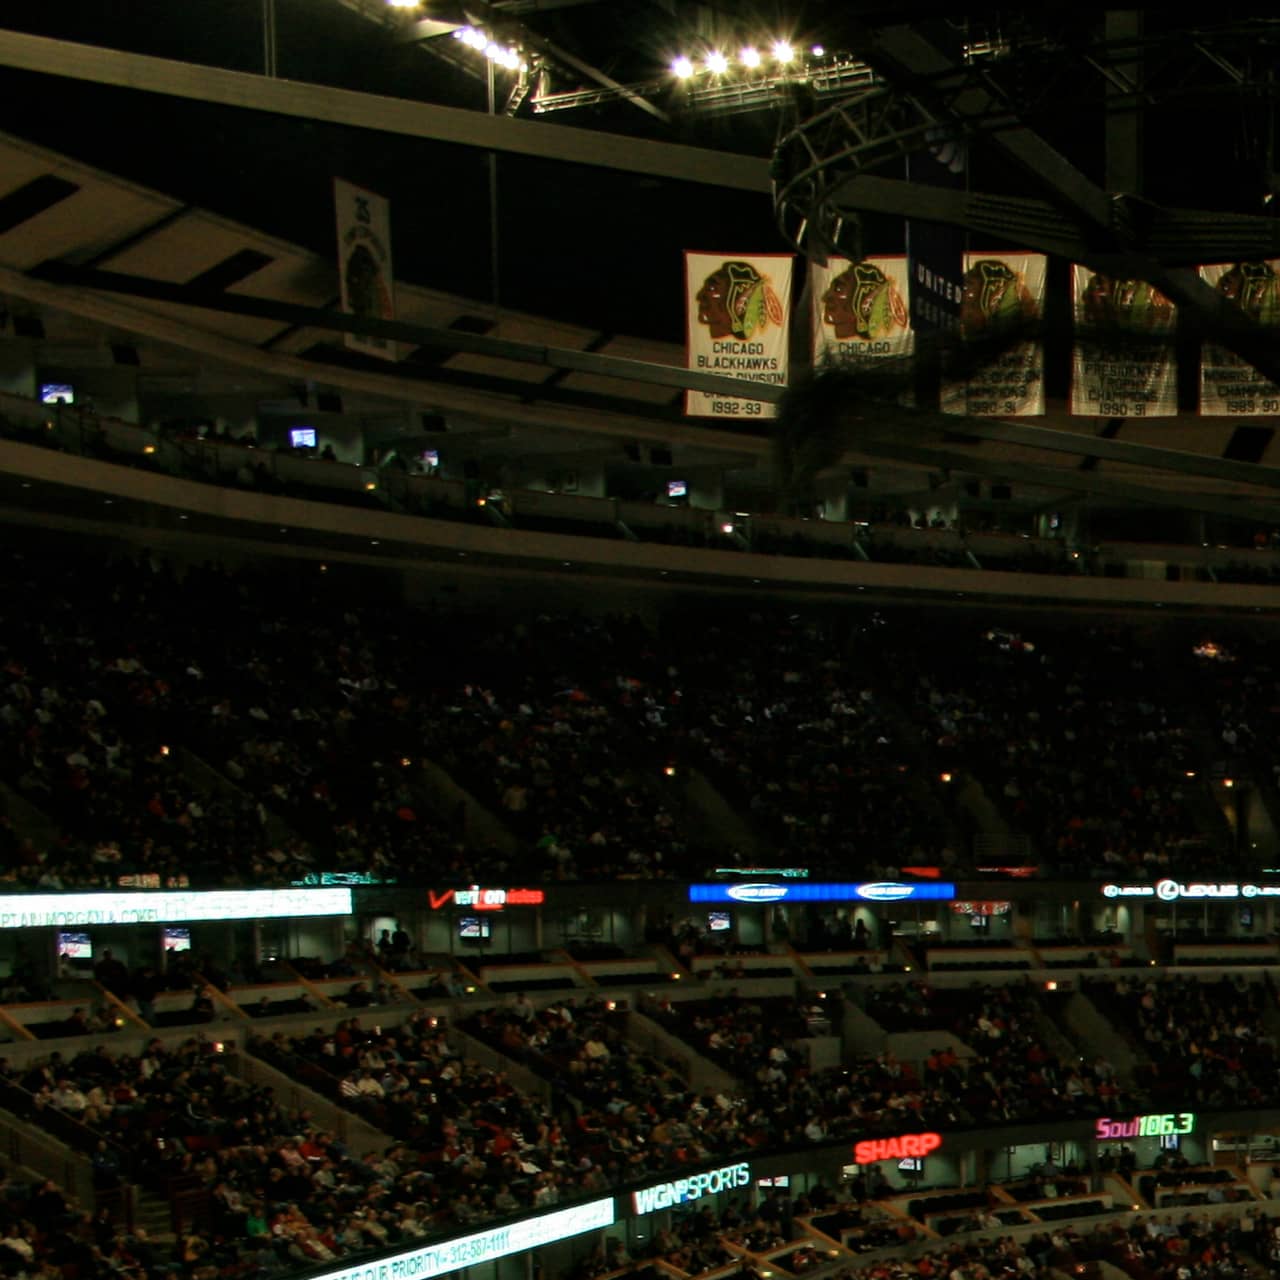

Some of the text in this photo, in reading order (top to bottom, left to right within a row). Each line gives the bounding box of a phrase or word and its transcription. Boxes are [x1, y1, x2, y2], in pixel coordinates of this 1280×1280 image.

[712, 342, 765, 355] CHICAGO
[697, 356, 779, 370] BLACKHAWKS
[712, 402, 762, 414] 1992-93
[1180, 884, 1239, 897] LEXUS
[1095, 1112, 1195, 1139] Soul 106.3
[854, 1132, 943, 1165] SHARP
[687, 1162, 751, 1200] SPORTS
